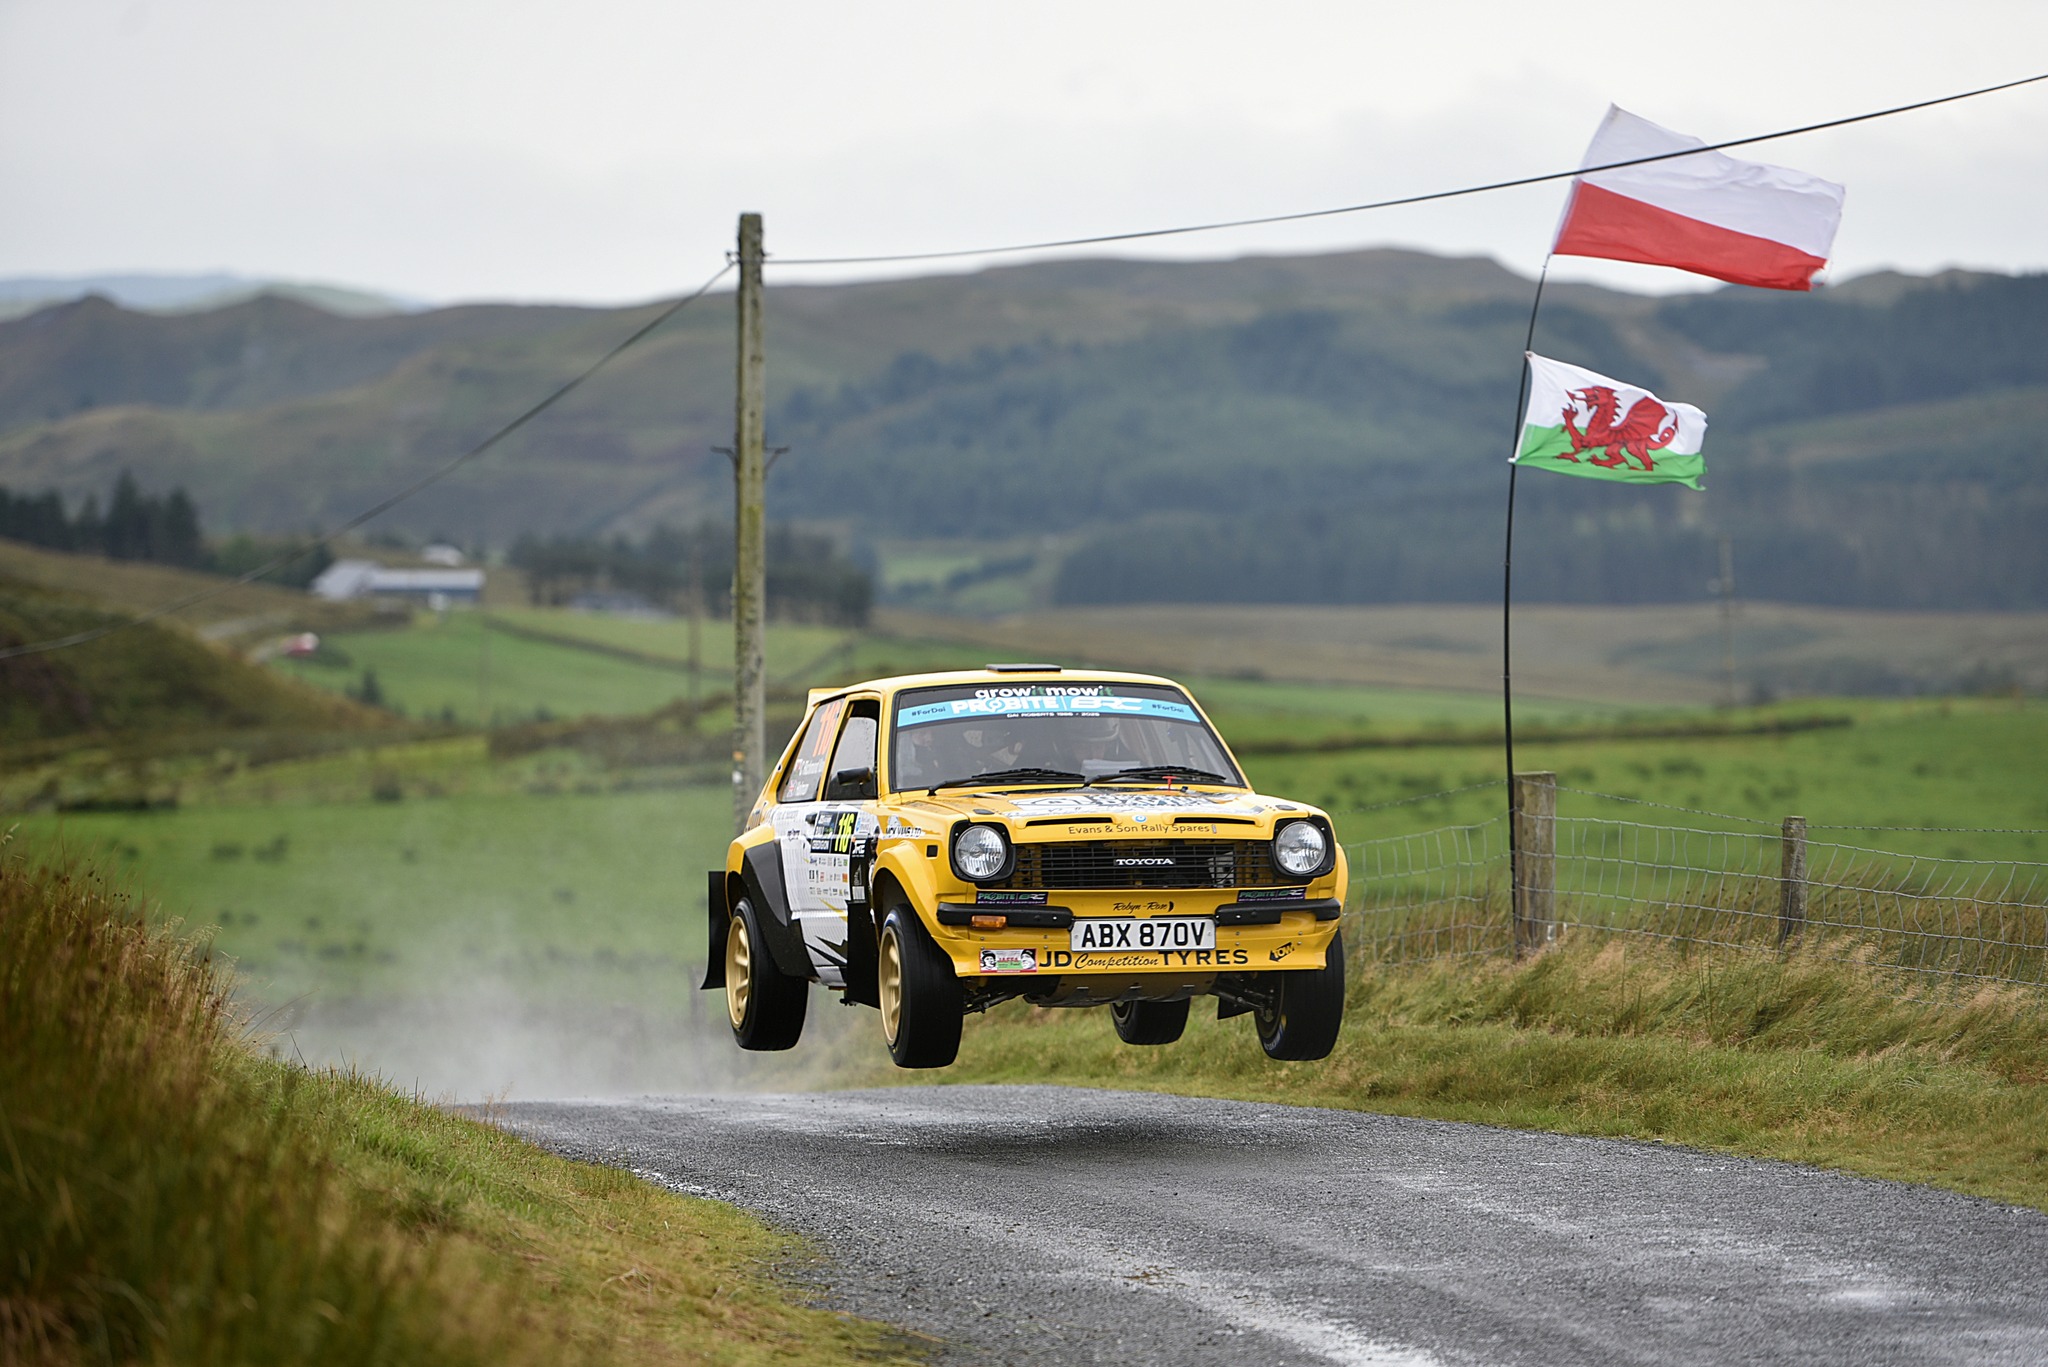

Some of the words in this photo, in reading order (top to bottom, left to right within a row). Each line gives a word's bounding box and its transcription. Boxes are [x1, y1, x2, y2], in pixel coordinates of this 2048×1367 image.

[975, 686, 1114, 700] growitmowit
[911, 706, 946, 717] #ForDai
[950, 696, 1058, 715] PROBITE
[1071, 696, 1143, 711] BRC
[1152, 703, 1185, 713] #ForDai
[834, 812, 855, 853] 116
[1068, 826, 1102, 834] Evans
[1104, 825, 1114, 833] &
[1116, 824, 1138, 833] Son
[1141, 824, 1170, 834] Rally
[1171, 824, 1211, 833] Spares
[1115, 858, 1174, 866] TOYOTA
[977, 892, 1015, 900] PROBITE
[1081, 923, 1131, 948] ABX
[1139, 922, 1206, 947] 870V
[1272, 943, 1296, 959] TOW
[1039, 951, 1072, 967] JD
[1074, 953, 1159, 969] Competition
[1158, 950, 1249, 966] TYRES
